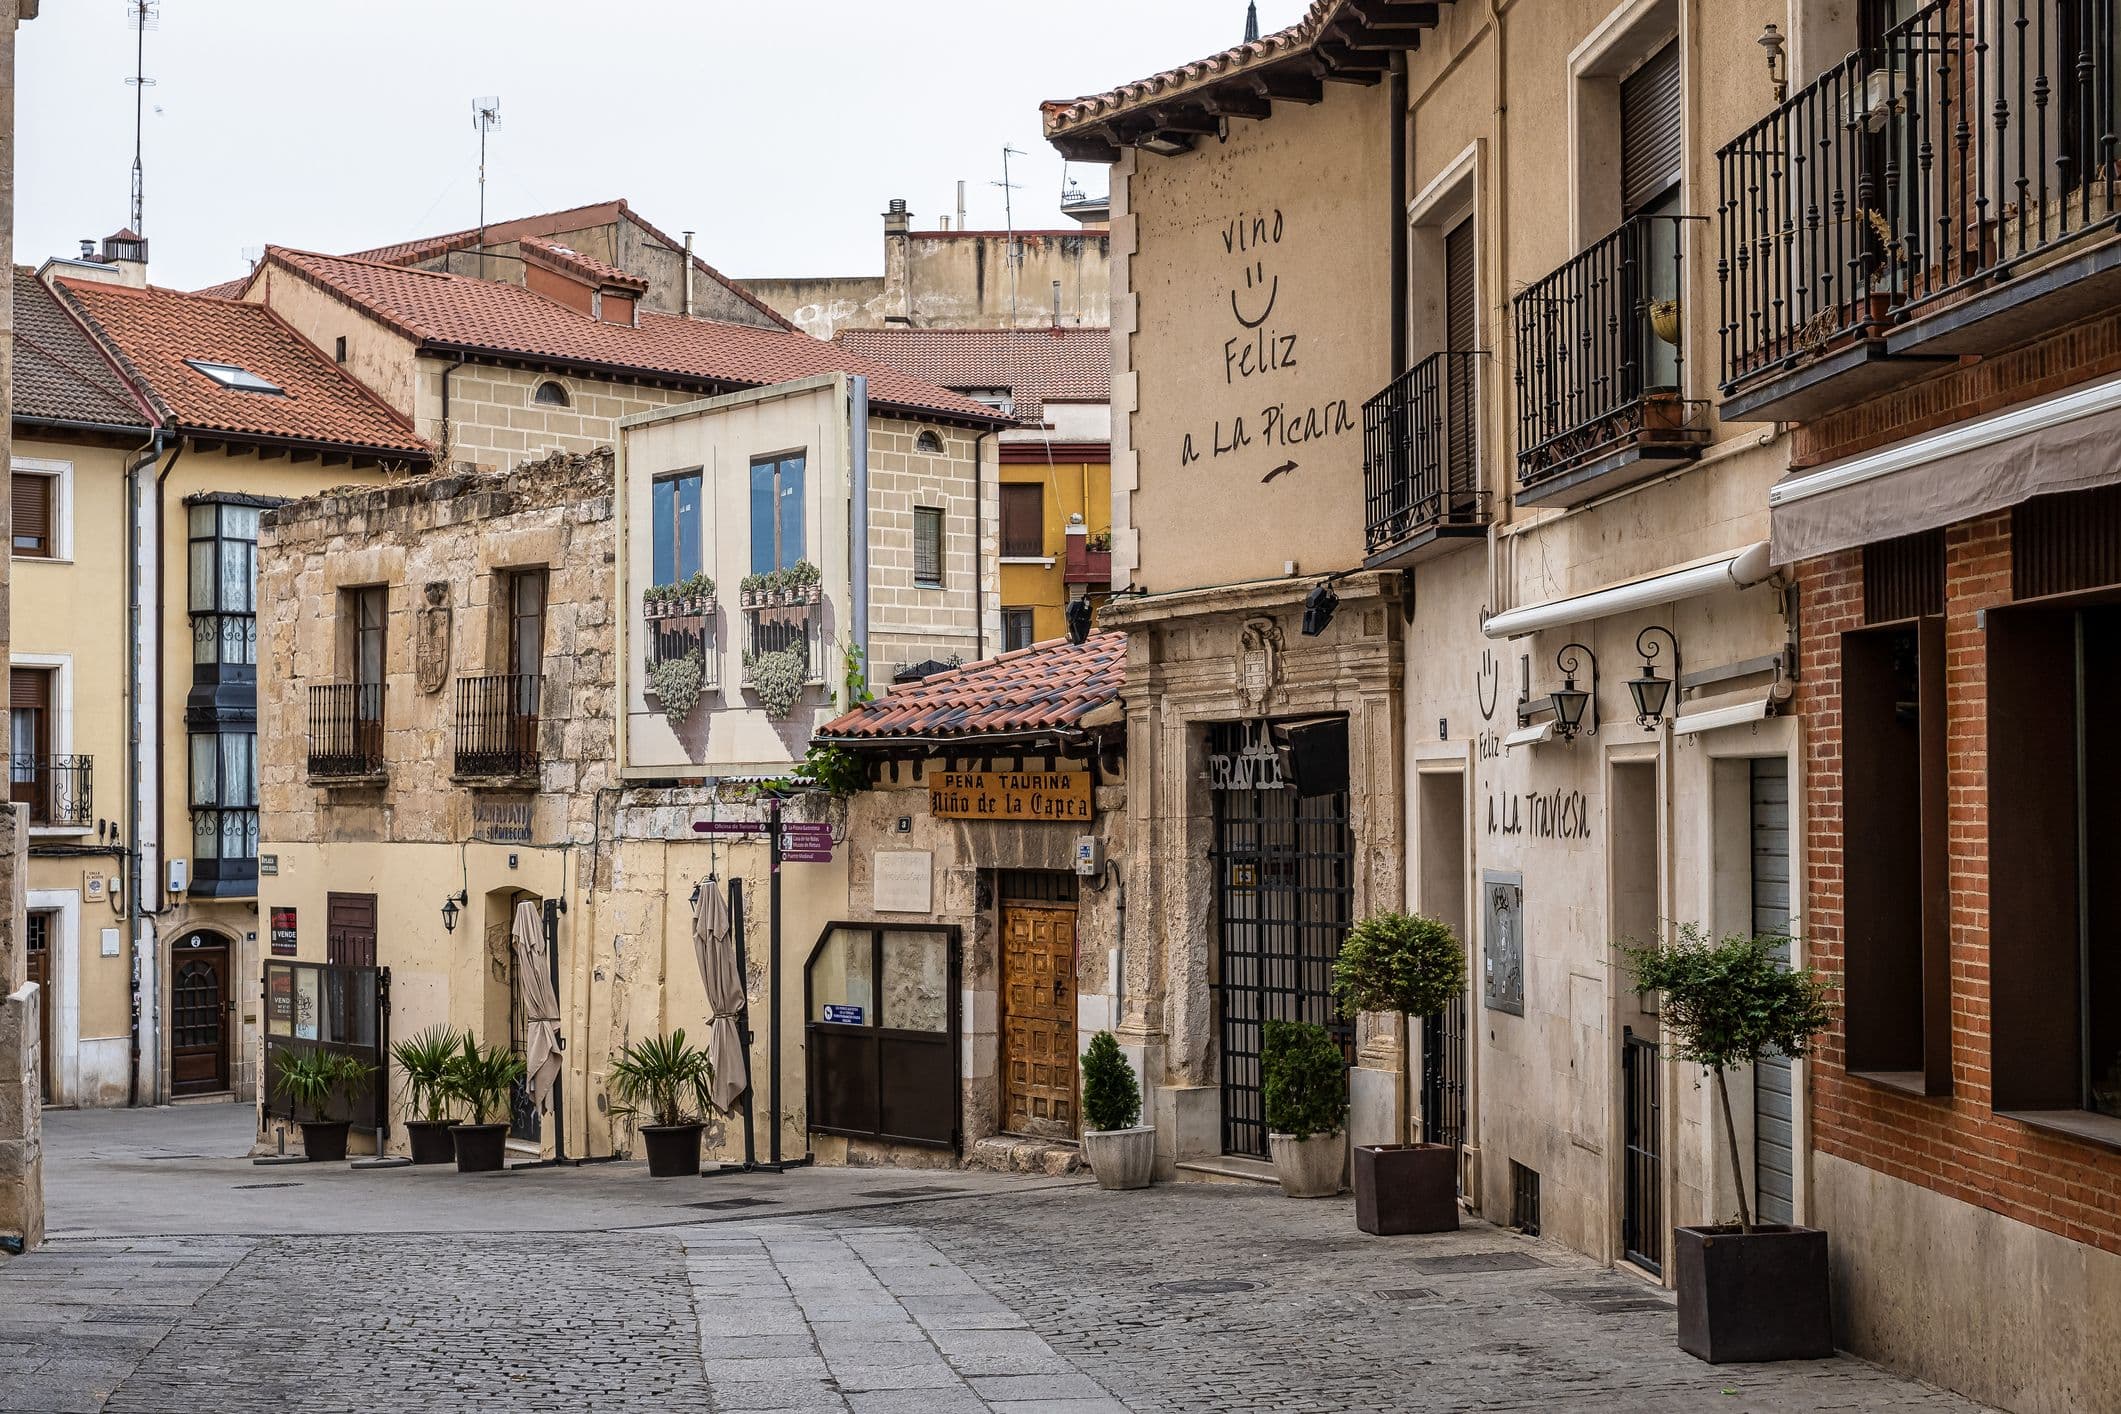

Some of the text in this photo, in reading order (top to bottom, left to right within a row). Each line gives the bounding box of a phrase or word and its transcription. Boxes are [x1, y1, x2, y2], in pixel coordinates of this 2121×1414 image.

[1225, 328, 1297, 384] Feliz
[1242, 720, 1275, 754] LA
[945, 773, 1071, 790] PEÑA TAURINA
[932, 791, 969, 816] Niño
[978, 793, 997, 814] de
[1006, 793, 1022, 814] la
[277, 930, 296, 939] VENDE
